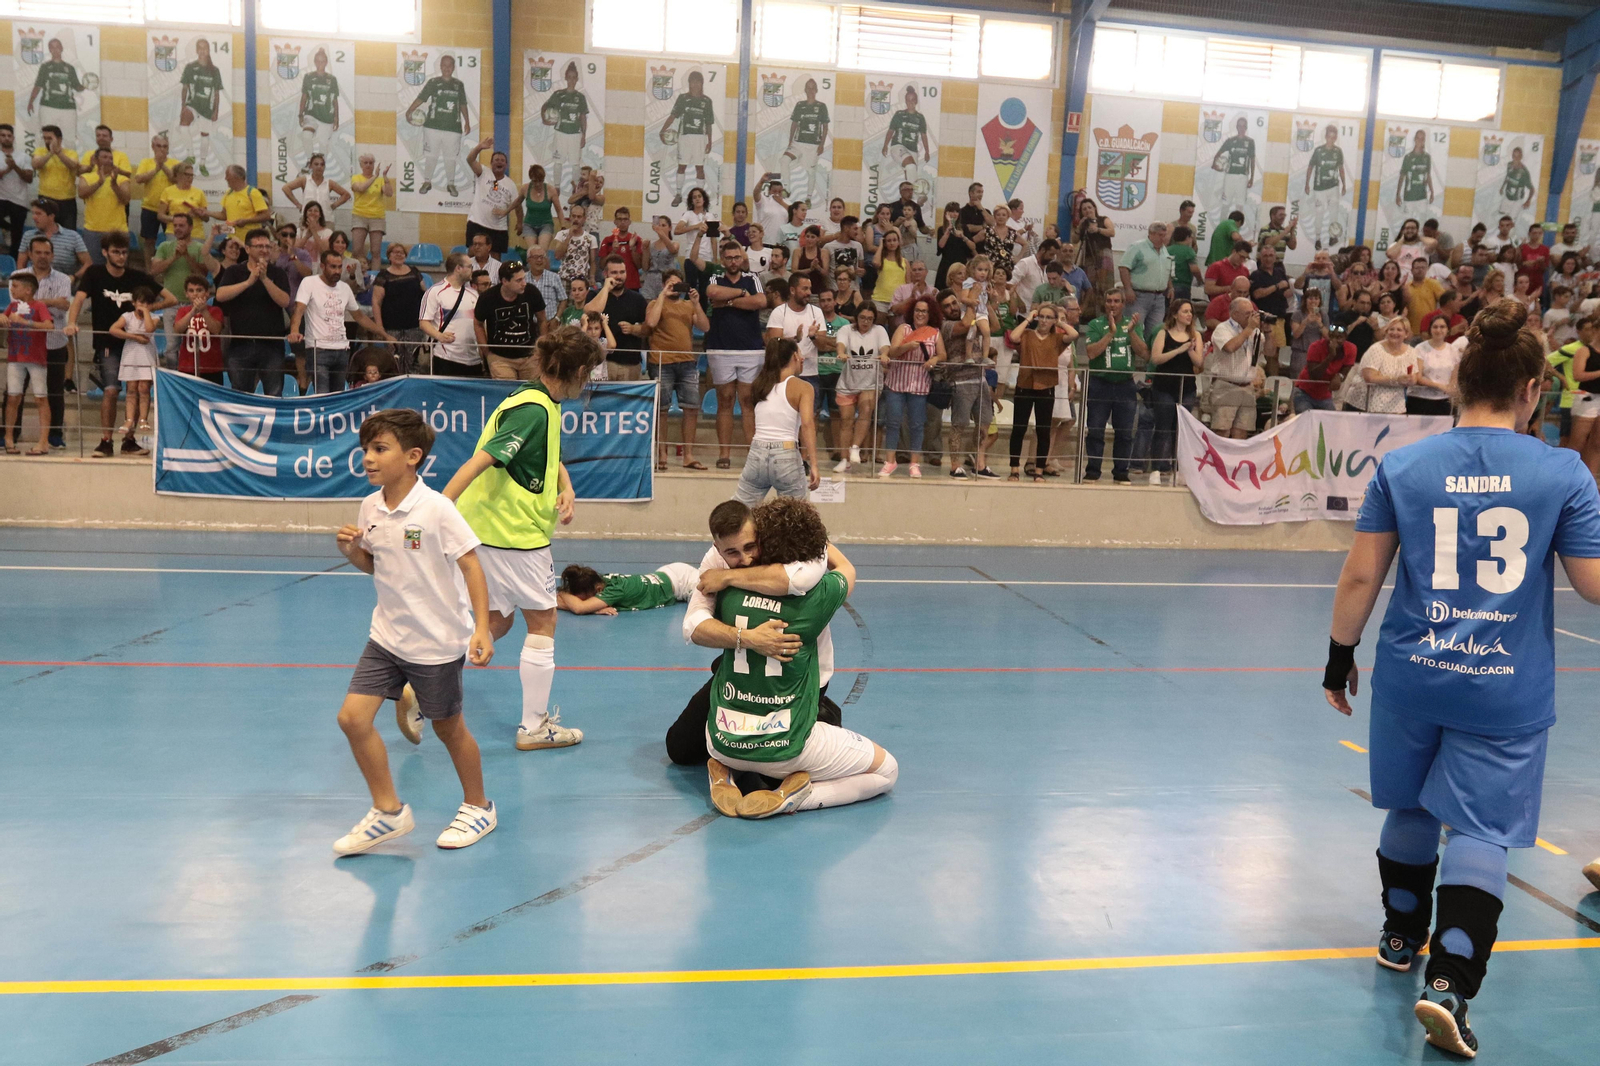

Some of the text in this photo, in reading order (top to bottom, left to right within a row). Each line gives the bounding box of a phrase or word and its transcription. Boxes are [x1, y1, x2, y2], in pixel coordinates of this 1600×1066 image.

[87, 34, 94, 47] 1
[212, 41, 230, 54] 14
[335, 50, 346, 63] 2
[456, 55, 477, 68] 13
[587, 62, 597, 75] 9
[708, 71, 717, 83] 7
[822, 78, 831, 90] 5
[921, 86, 938, 98] 10
[1256, 116, 1264, 127] 6
[1341, 125, 1353, 137] 11
[1433, 132, 1446, 143] 12
[1531, 141, 1539, 152] 8
[276, 136, 287, 183] AGUEDA
[645, 160, 661, 204] CLARA
[864, 164, 880, 215] OGALLA
[1196, 211, 1208, 241] INMA
[1376, 227, 1389, 251] BIBI
[294, 401, 468, 439] Dipuión
[294, 449, 333, 478] de
[1446, 475, 1512, 493] SANDRA
[1431, 506, 1530, 595] 13
[742, 595, 782, 614] LORENA
[1410, 654, 1515, 676] AYTO.GUADALCACIN
